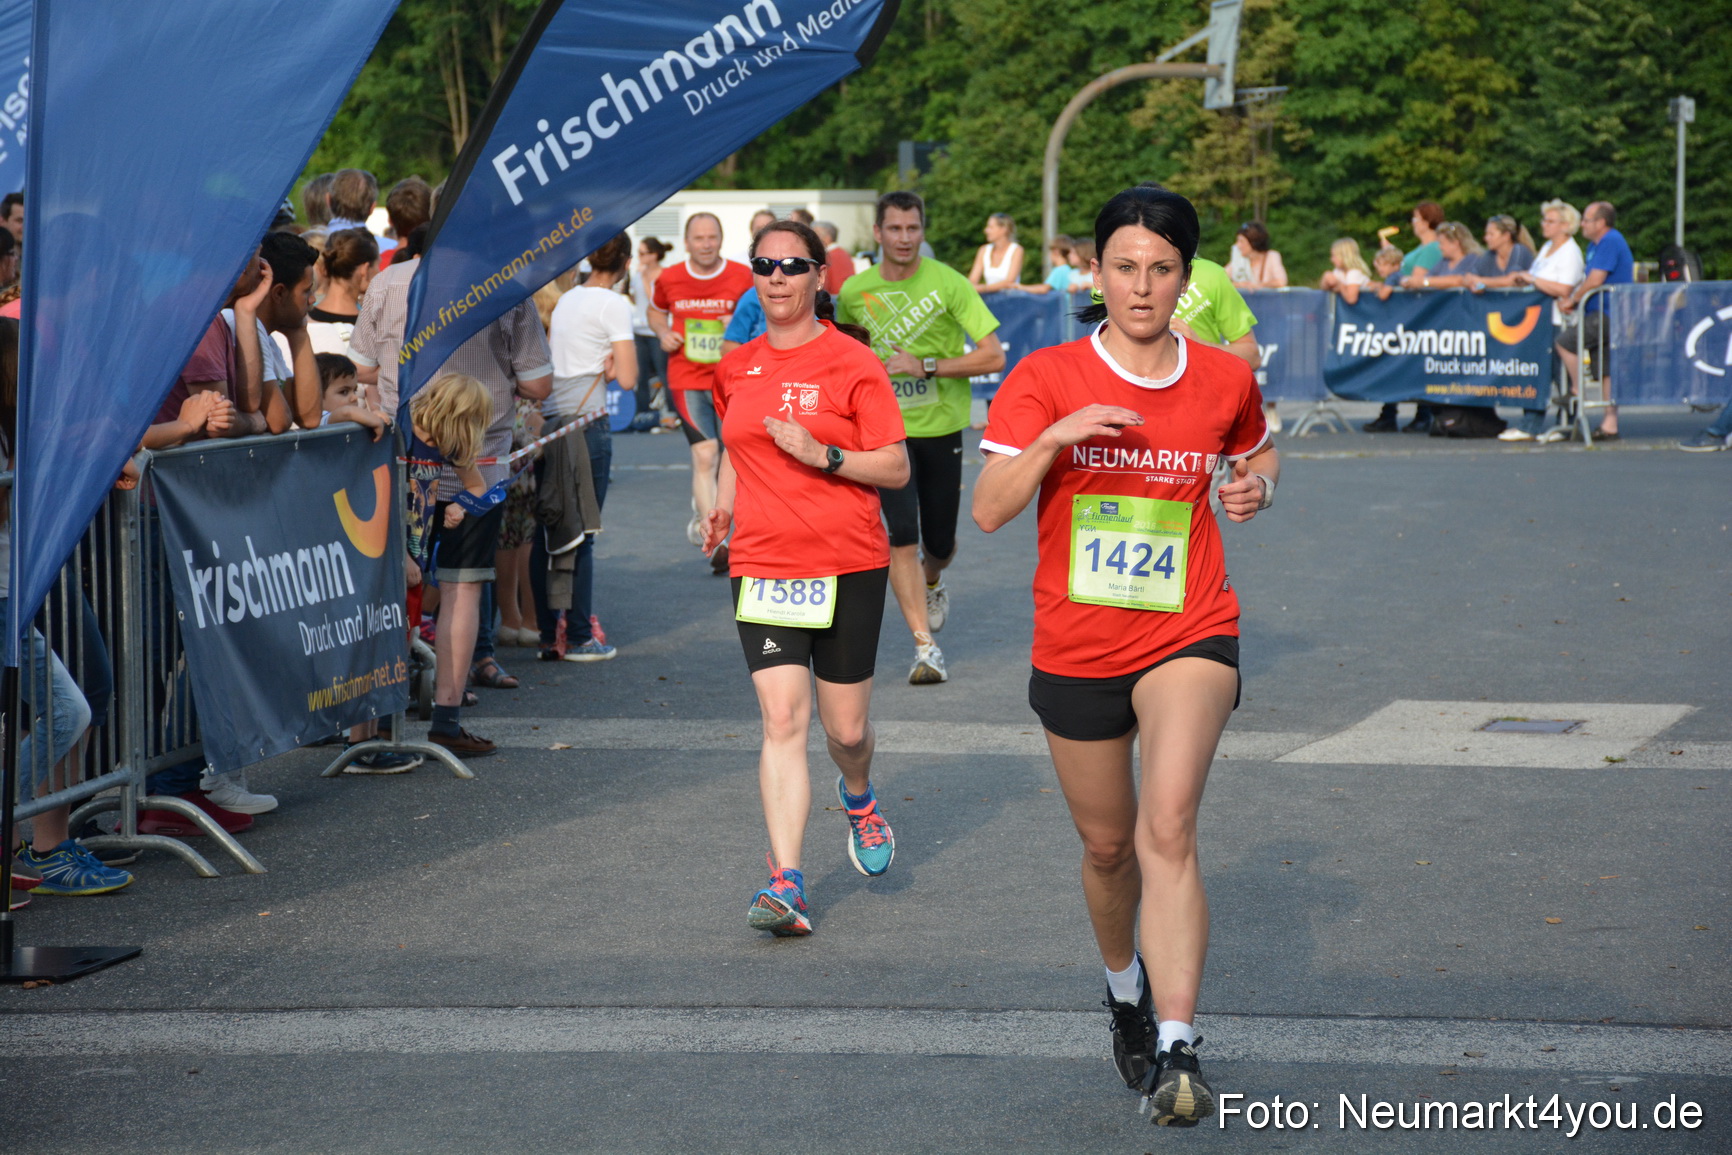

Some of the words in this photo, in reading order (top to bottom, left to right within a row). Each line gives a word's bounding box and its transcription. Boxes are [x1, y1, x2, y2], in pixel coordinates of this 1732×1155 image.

[683, 58, 752, 116] Druck
[753, 30, 800, 69] und
[491, 0, 782, 206] Frischmann
[1337, 323, 1486, 357] Frischmann
[1425, 357, 1460, 374] Druck
[1463, 357, 1486, 375] und
[1489, 358, 1538, 376] Medien
[1073, 444, 1202, 473] NEUMARKT
[1145, 475, 1174, 484] STARKE
[1175, 477, 1196, 485] STADT
[1092, 512, 1134, 524] firmenlauf
[1085, 538, 1175, 579] 1424
[182, 535, 355, 629] Frischmann
[753, 578, 826, 606] 1588
[1108, 582, 1127, 592] Maria
[298, 613, 336, 656] Druck
[335, 604, 364, 648] und
